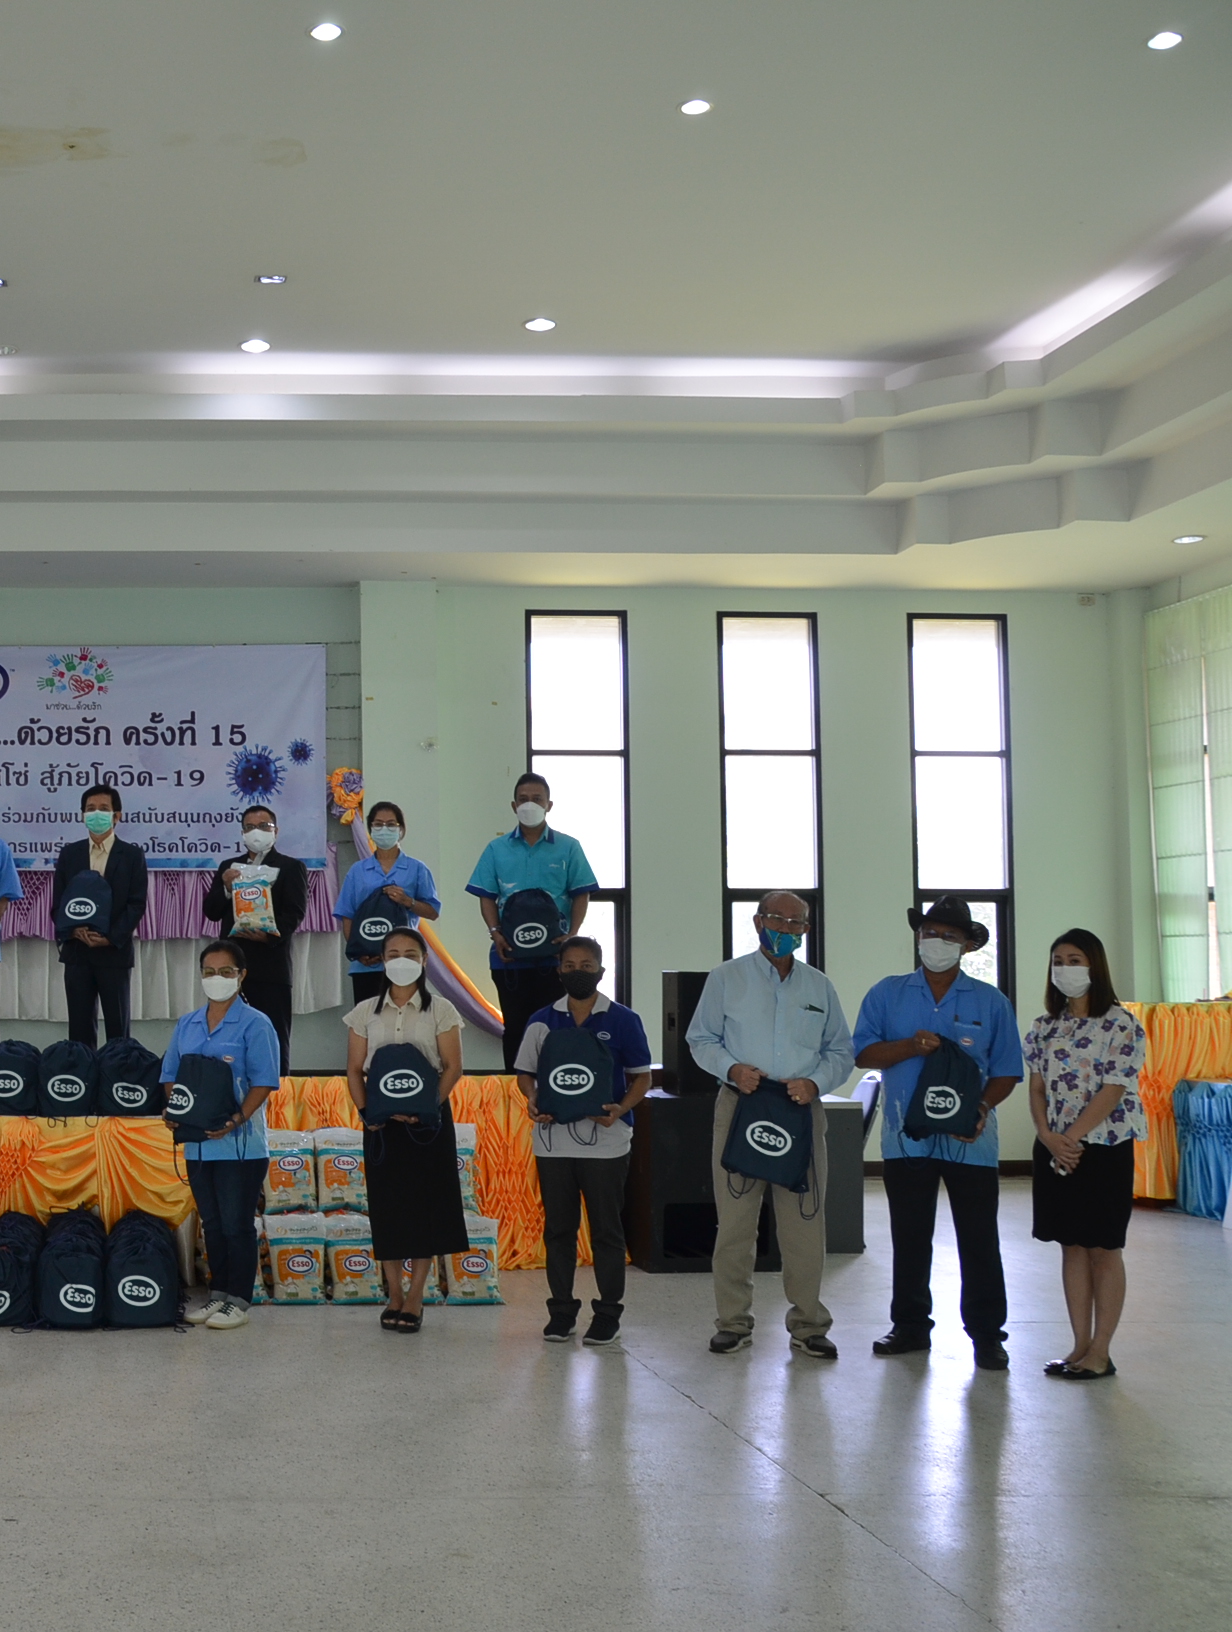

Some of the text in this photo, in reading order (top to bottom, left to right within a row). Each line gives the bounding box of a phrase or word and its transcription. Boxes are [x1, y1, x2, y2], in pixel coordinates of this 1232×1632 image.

[122, 711, 197, 747] ครั้งที่
[210, 723, 247, 747] 15
[39, 762, 206, 793] สู้ภัยโควิด-19
[69, 903, 91, 913] Esso
[364, 923, 388, 933] Esso
[518, 930, 542, 941] Esso
[387, 1078, 417, 1089] Esso
[556, 1072, 588, 1085] Esso
[54, 1081, 79, 1093] Esso
[117, 1087, 141, 1100] Esso
[753, 1127, 785, 1148] Esso
[337, 1159, 354, 1167] Esso
[348, 1259, 367, 1267] Esso
[466, 1260, 485, 1268] Esso
[124, 1282, 154, 1298] Esso
